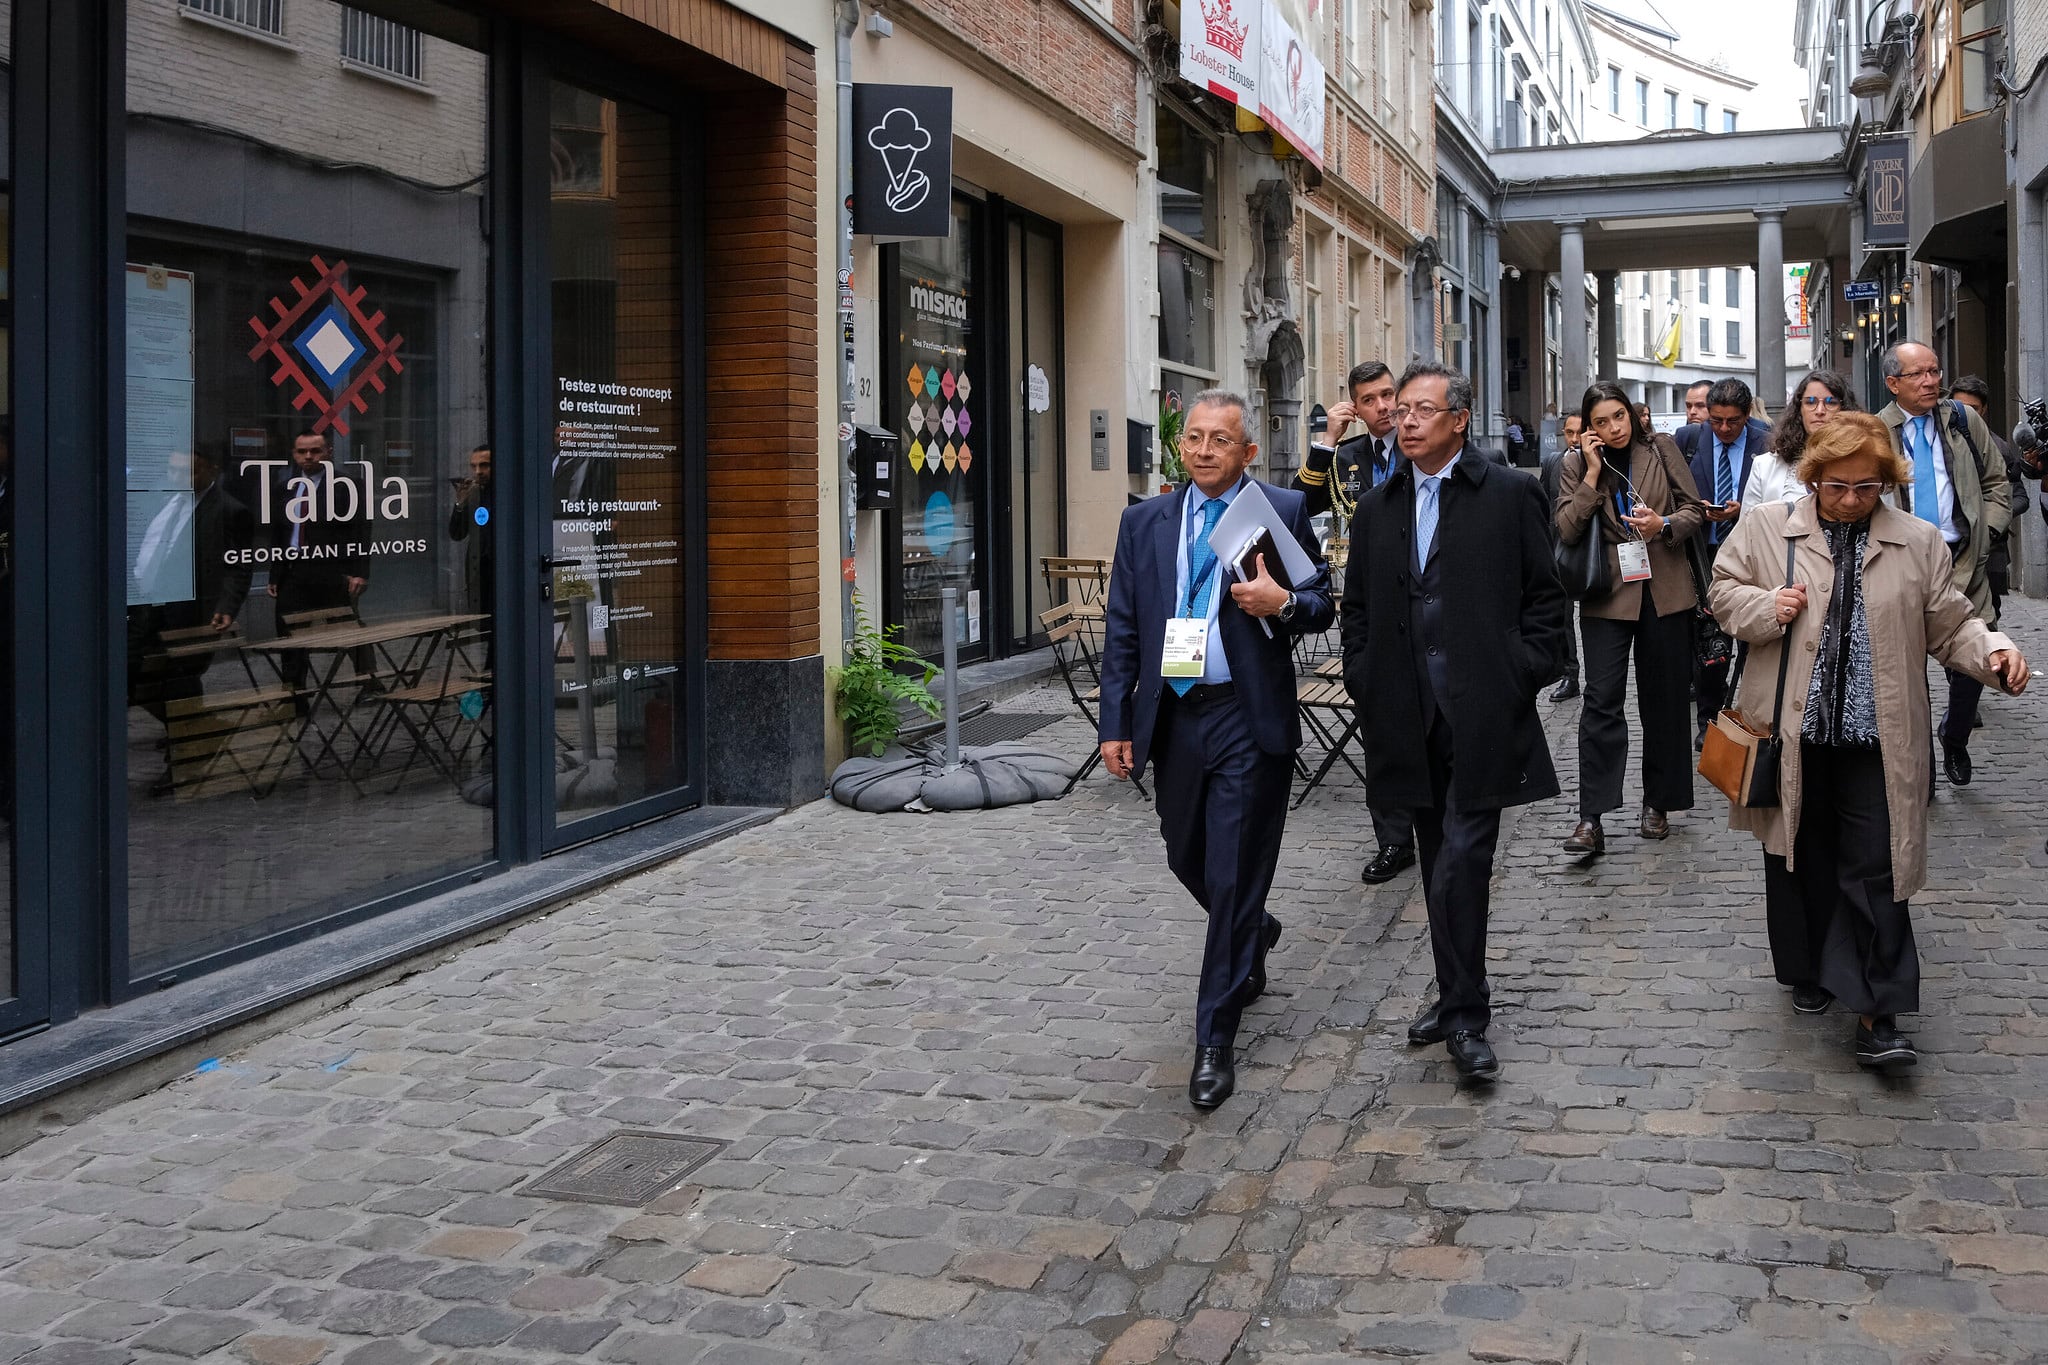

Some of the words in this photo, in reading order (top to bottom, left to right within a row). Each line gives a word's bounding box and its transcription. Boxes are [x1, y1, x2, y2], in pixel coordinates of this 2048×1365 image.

[1190, 44, 1227, 76] Lobster
[1228, 63, 1255, 91] House
[912, 338, 922, 348] Nos
[559, 377, 596, 394] Testez
[598, 383, 628, 397] votre
[629, 387, 672, 403] concept
[860, 377, 871, 397] 32
[559, 397, 574, 412] de
[576, 402, 635, 416] restaurant
[637, 404, 641, 416] !
[560, 420, 573, 429] Chez
[643, 426, 660, 434] risques
[560, 449, 573, 457] dans
[240, 460, 410, 524] Tabla
[560, 499, 586, 513] Test
[587, 498, 599, 516] je
[601, 498, 662, 513] restaurant-
[561, 518, 612, 535] concept!
[223, 544, 339, 565] GEORGIAN
[346, 539, 428, 557] FLAVORS
[651, 557, 678, 566] ondersteunt
[561, 574, 567, 583] je
[574, 573, 581, 581] de
[581, 572, 600, 580] opstart
